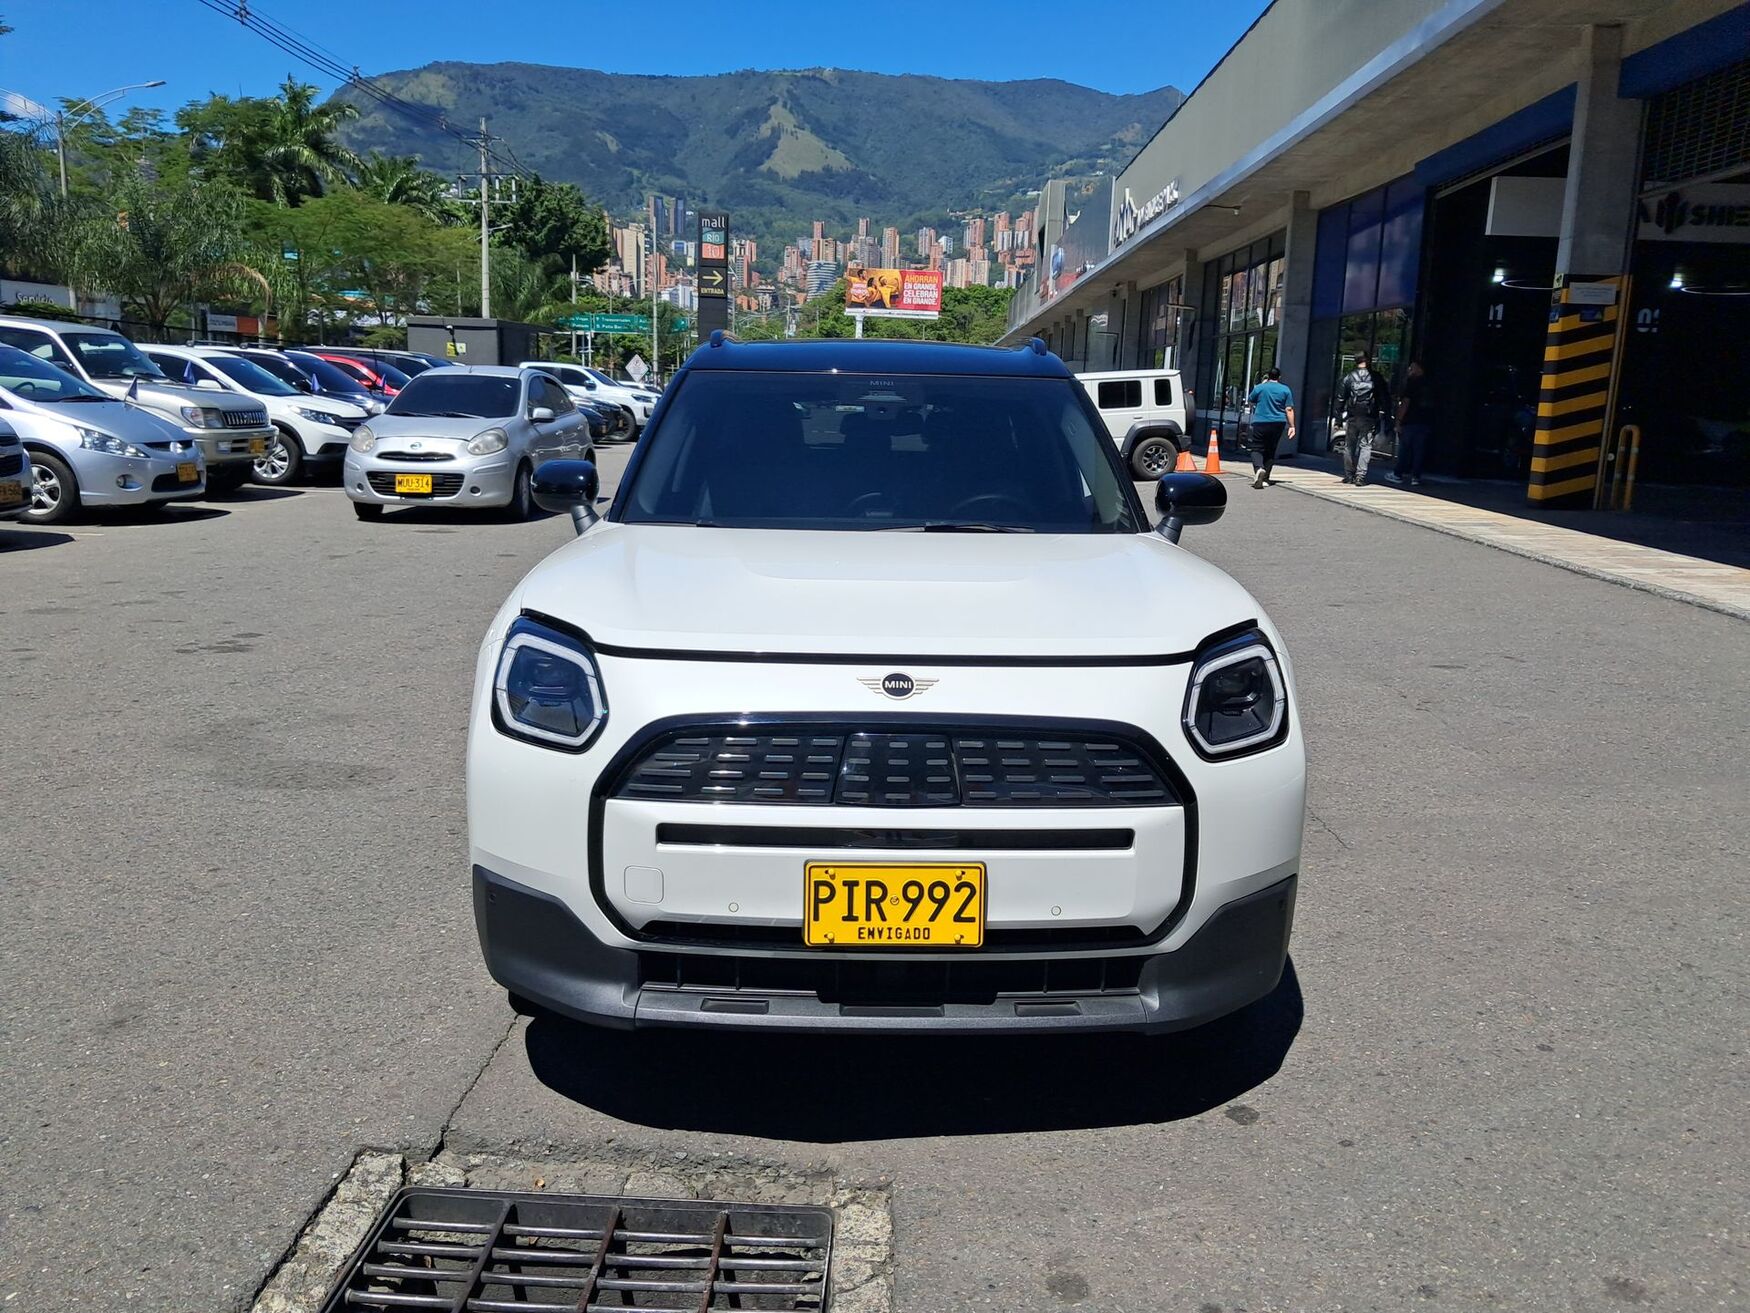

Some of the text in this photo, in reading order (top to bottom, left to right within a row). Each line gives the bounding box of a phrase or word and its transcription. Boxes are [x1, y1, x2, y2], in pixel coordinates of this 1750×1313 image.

[701, 216, 725, 228] mall
[701, 287, 725, 295] ENTRADA
[903, 289, 938, 298] CELEBRAN
[884, 680, 912, 689] MINI
[857, 926, 931, 941] ENVIGADO
